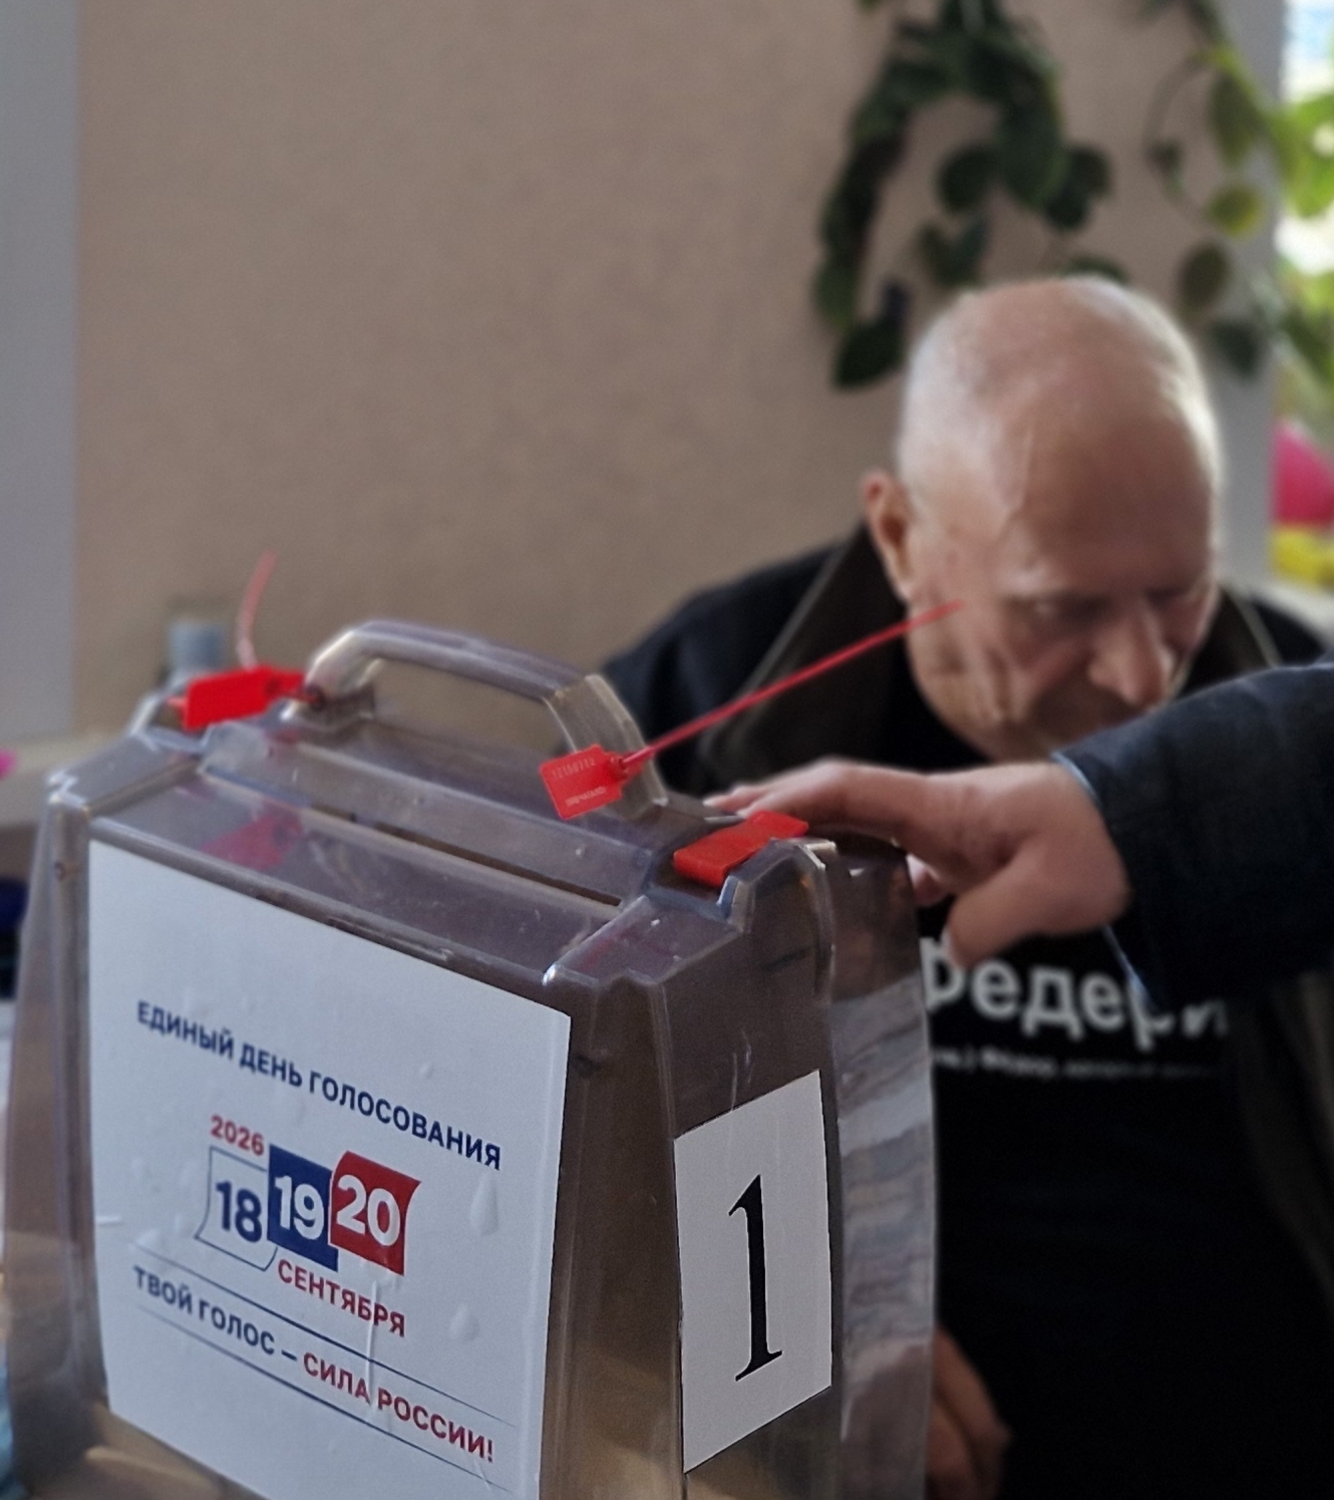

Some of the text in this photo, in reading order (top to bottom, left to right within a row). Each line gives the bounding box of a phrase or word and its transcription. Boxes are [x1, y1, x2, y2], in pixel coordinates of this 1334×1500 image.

[136, 999, 502, 1171] ЕДИНЫЙ ДЕНЬ ГОЛОСОВАНИЯ
[209, 1114, 265, 1157] 2026
[215, 1173, 401, 1247] 18 19 20
[277, 1258, 406, 1338] СЕНТЯБРЯ
[727, 1173, 783, 1382] 1
[133, 1265, 194, 1316] ТВОЙ
[197, 1298, 275, 1356] ГОЛОС
[302, 1351, 371, 1404] СИЛА
[376, 1386, 495, 1464] РОССИИ!
